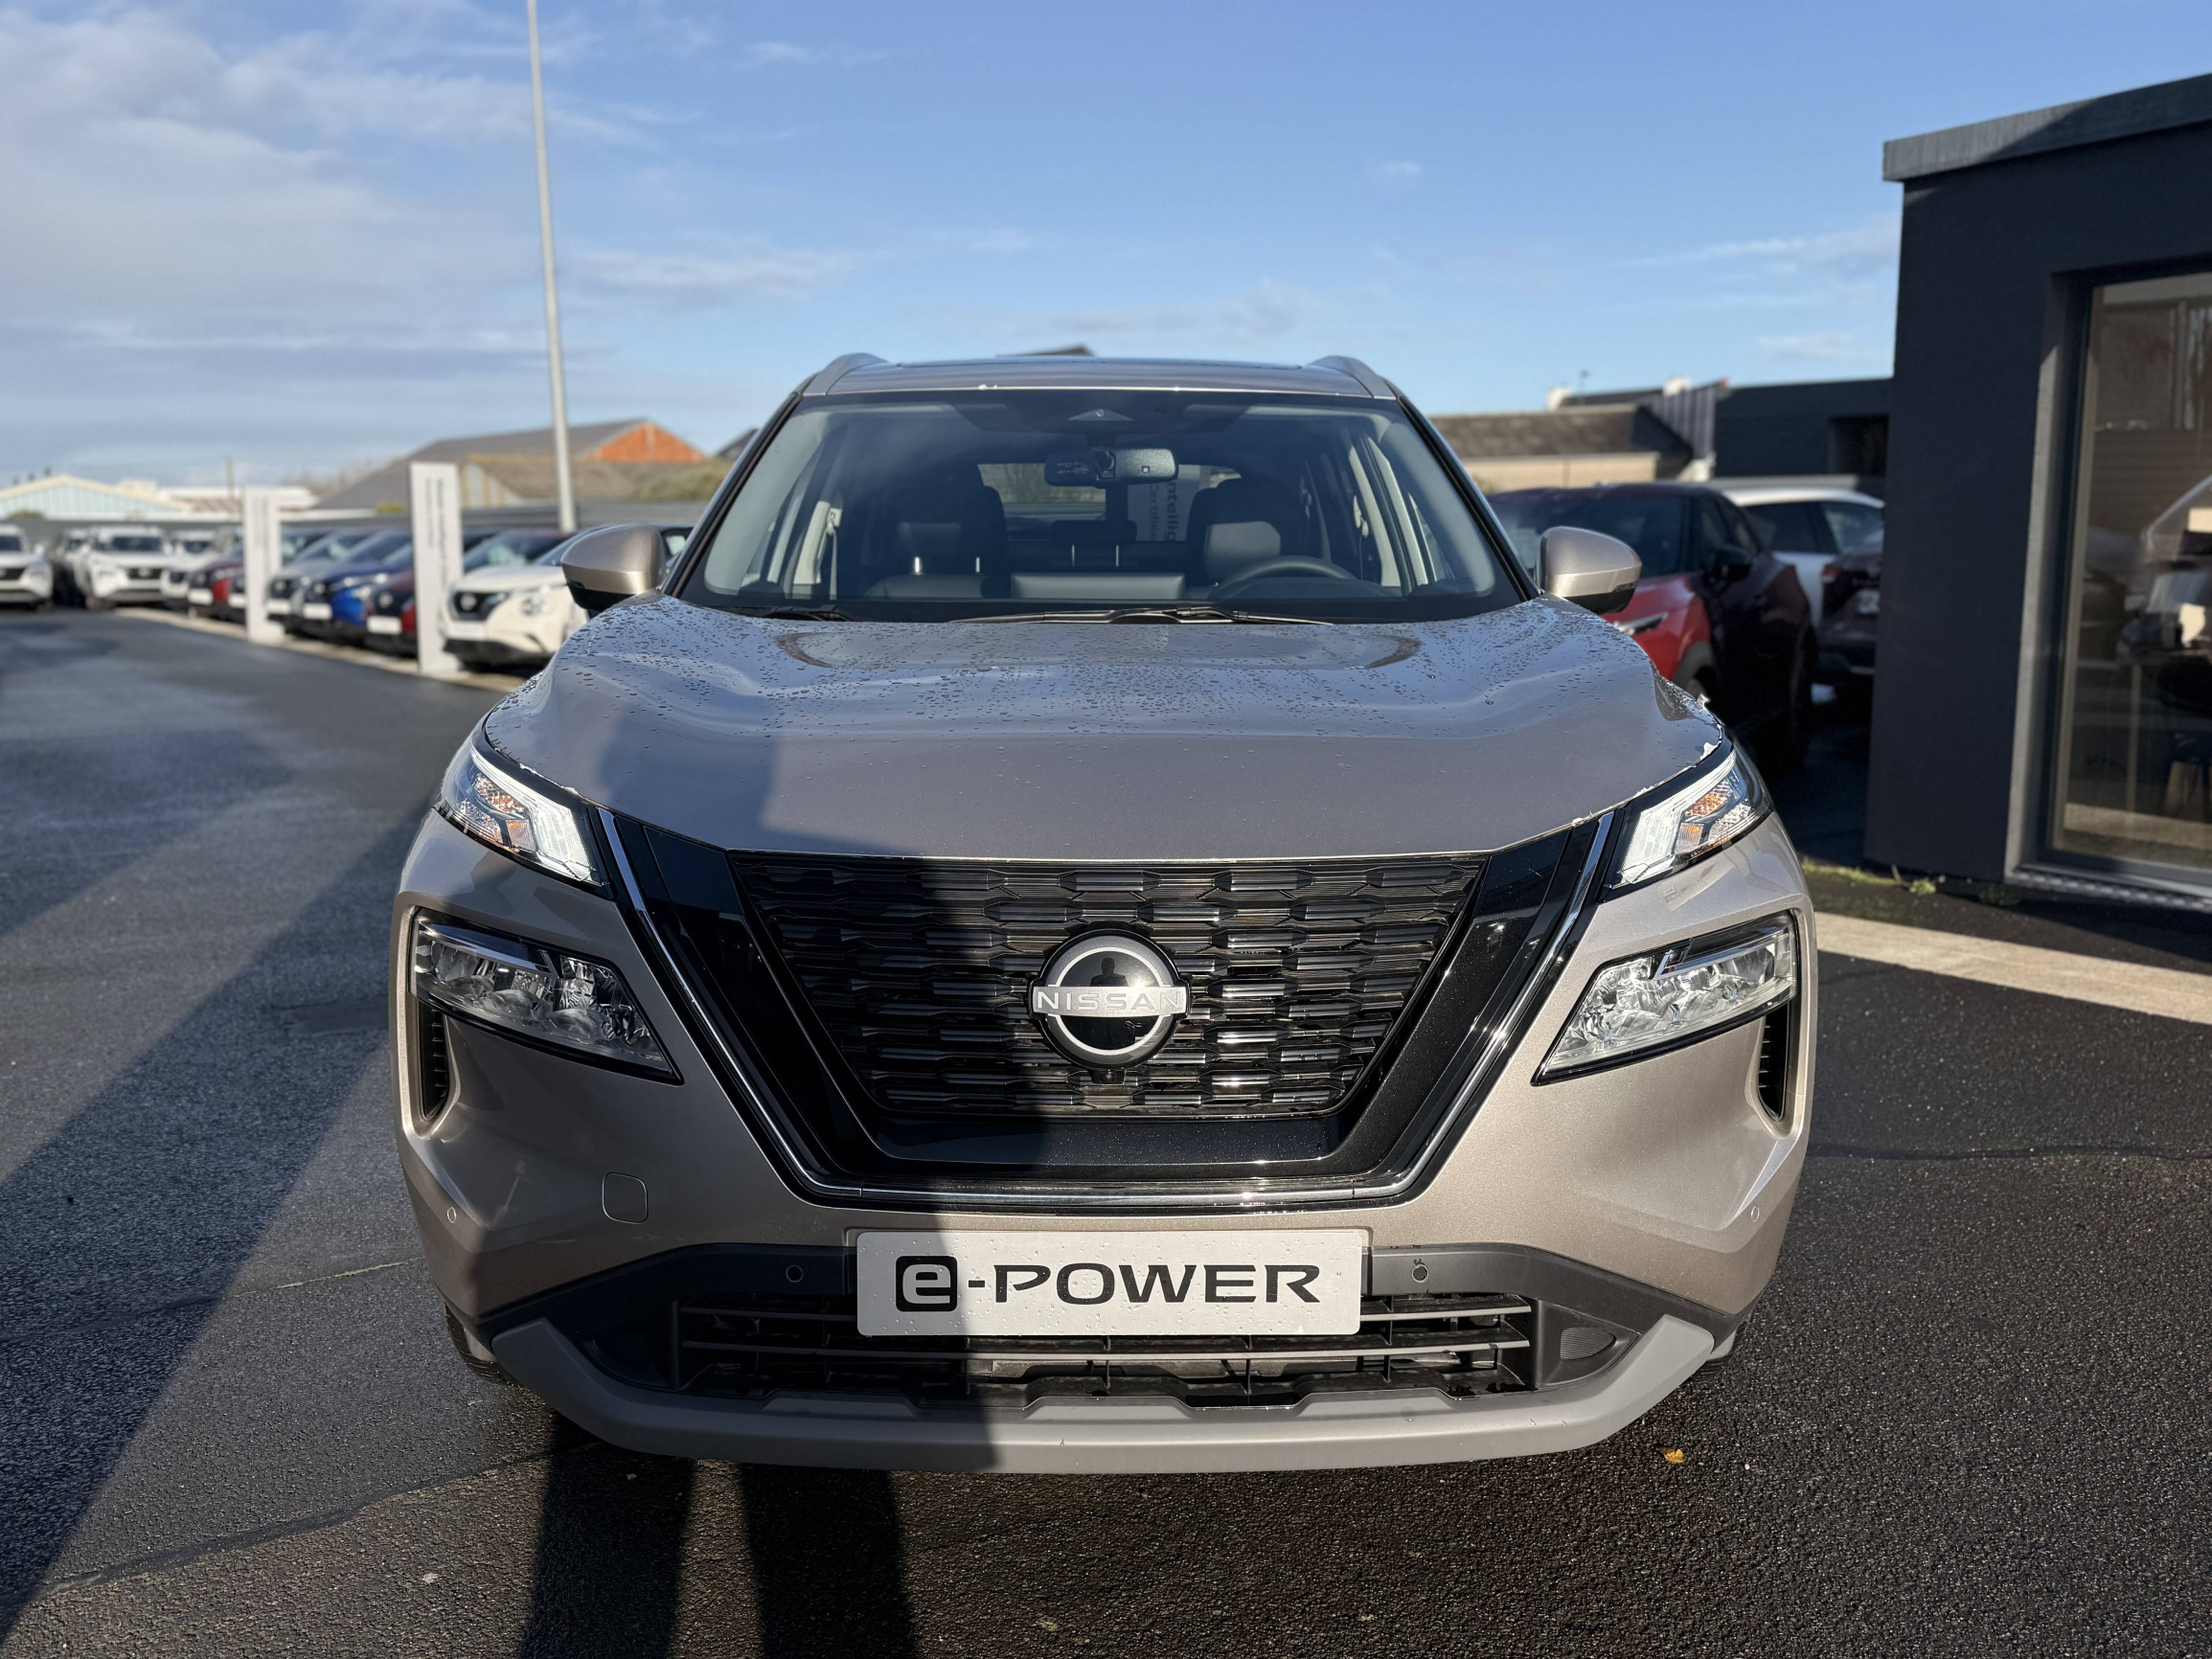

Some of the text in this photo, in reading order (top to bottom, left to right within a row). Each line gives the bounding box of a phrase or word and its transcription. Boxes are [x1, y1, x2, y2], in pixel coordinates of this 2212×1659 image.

[1164, 482, 1179, 541] ntellig
[1037, 990, 1181, 1011] NISSAN
[896, 1256, 1320, 1311] e-POWER
